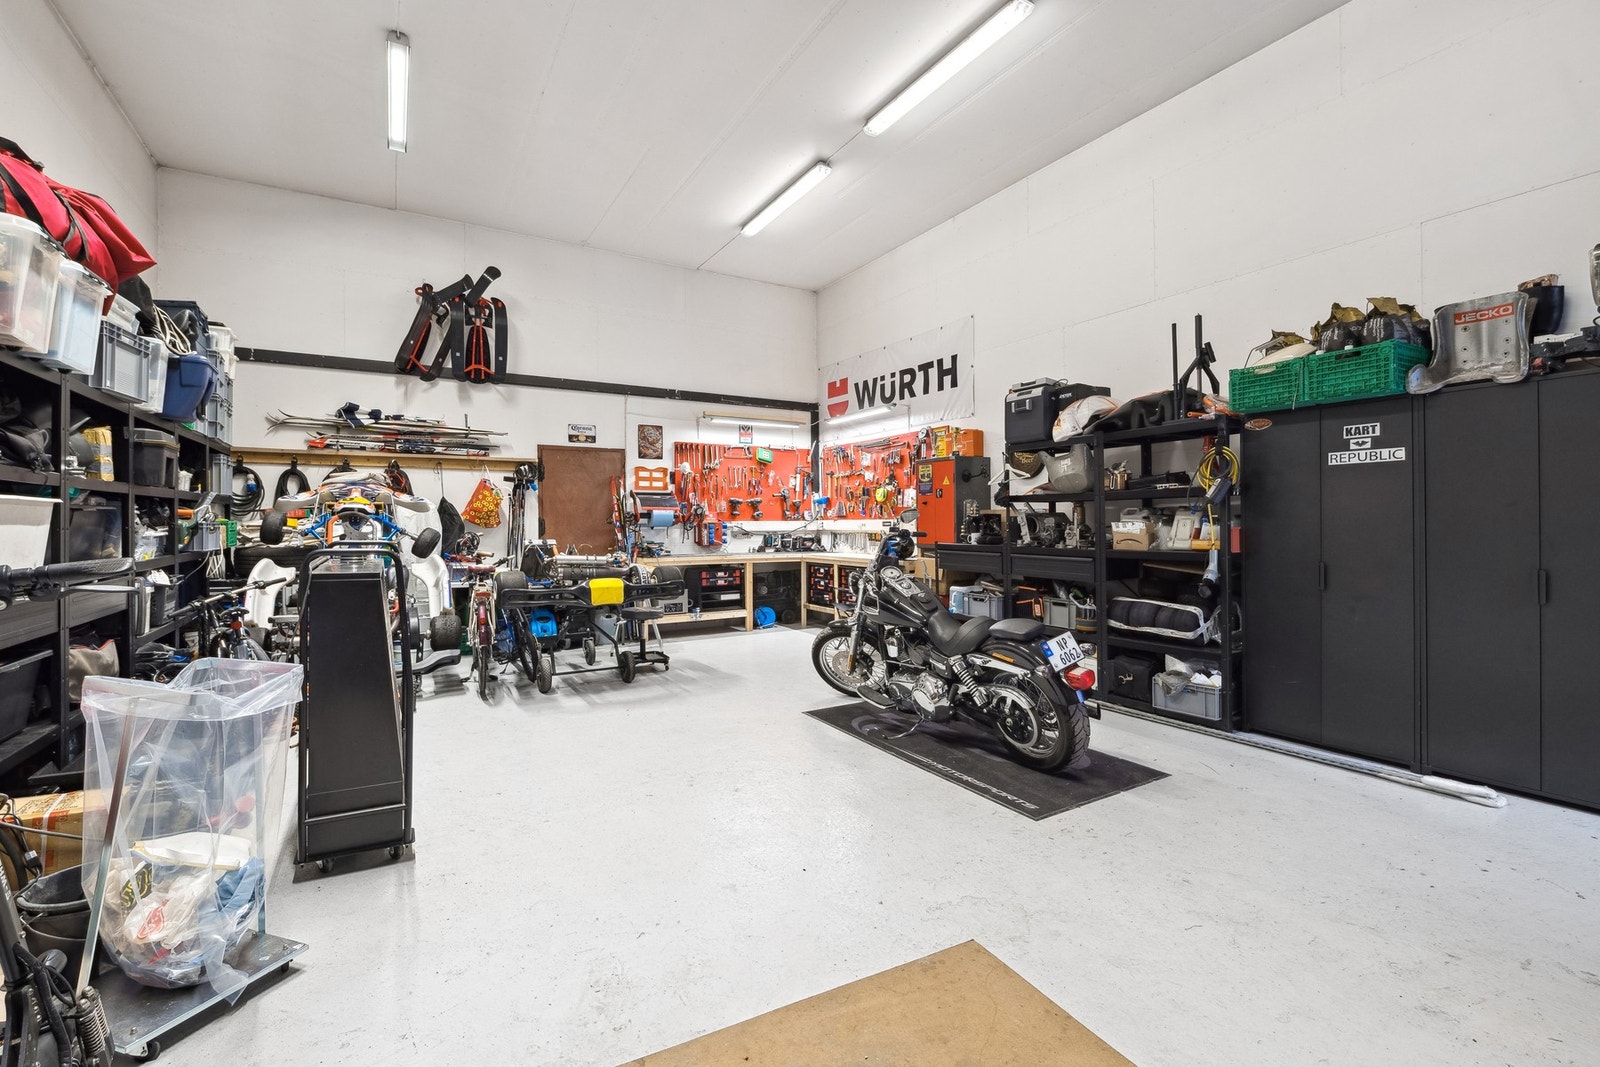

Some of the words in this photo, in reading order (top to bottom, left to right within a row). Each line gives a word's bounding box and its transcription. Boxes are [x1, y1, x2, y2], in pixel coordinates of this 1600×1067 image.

[1455, 305, 1513, 323] JECKO
[854, 353, 958, 410] WÜRTH
[1345, 424, 1378, 437] KART
[1329, 449, 1403, 464] REPUBLIC
[1056, 637, 1069, 651] NP
[1059, 647, 1081, 665] 6062
